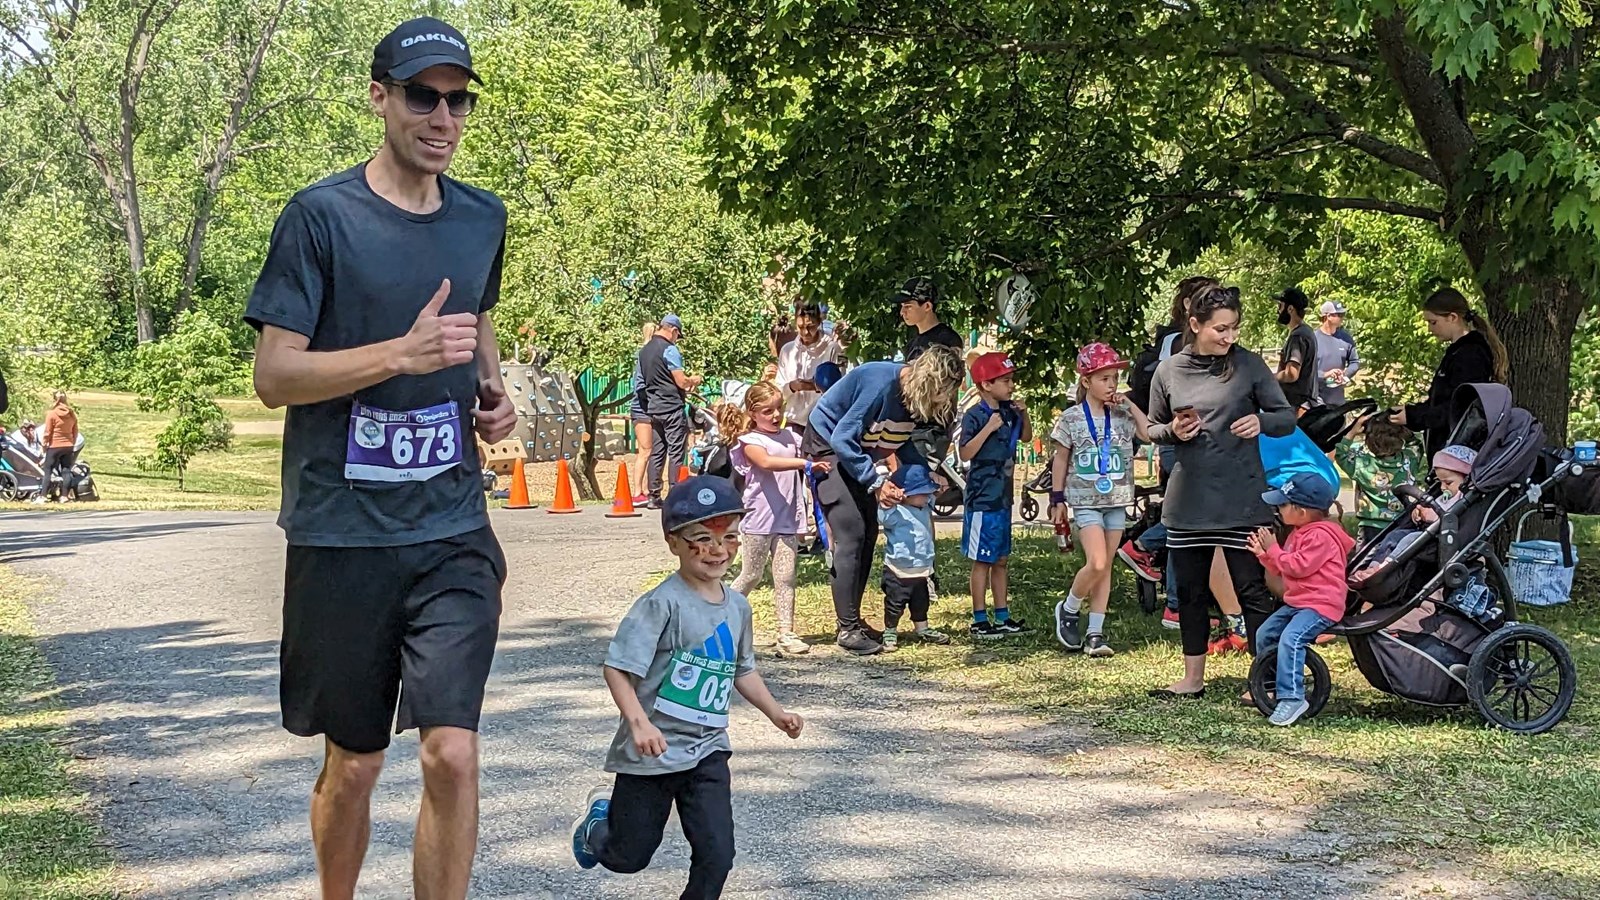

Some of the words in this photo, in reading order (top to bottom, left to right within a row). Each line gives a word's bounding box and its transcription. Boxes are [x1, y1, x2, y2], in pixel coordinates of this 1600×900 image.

[401, 33, 466, 51] OAKLEY
[392, 424, 455, 465] 673
[698, 675, 733, 711] 03
